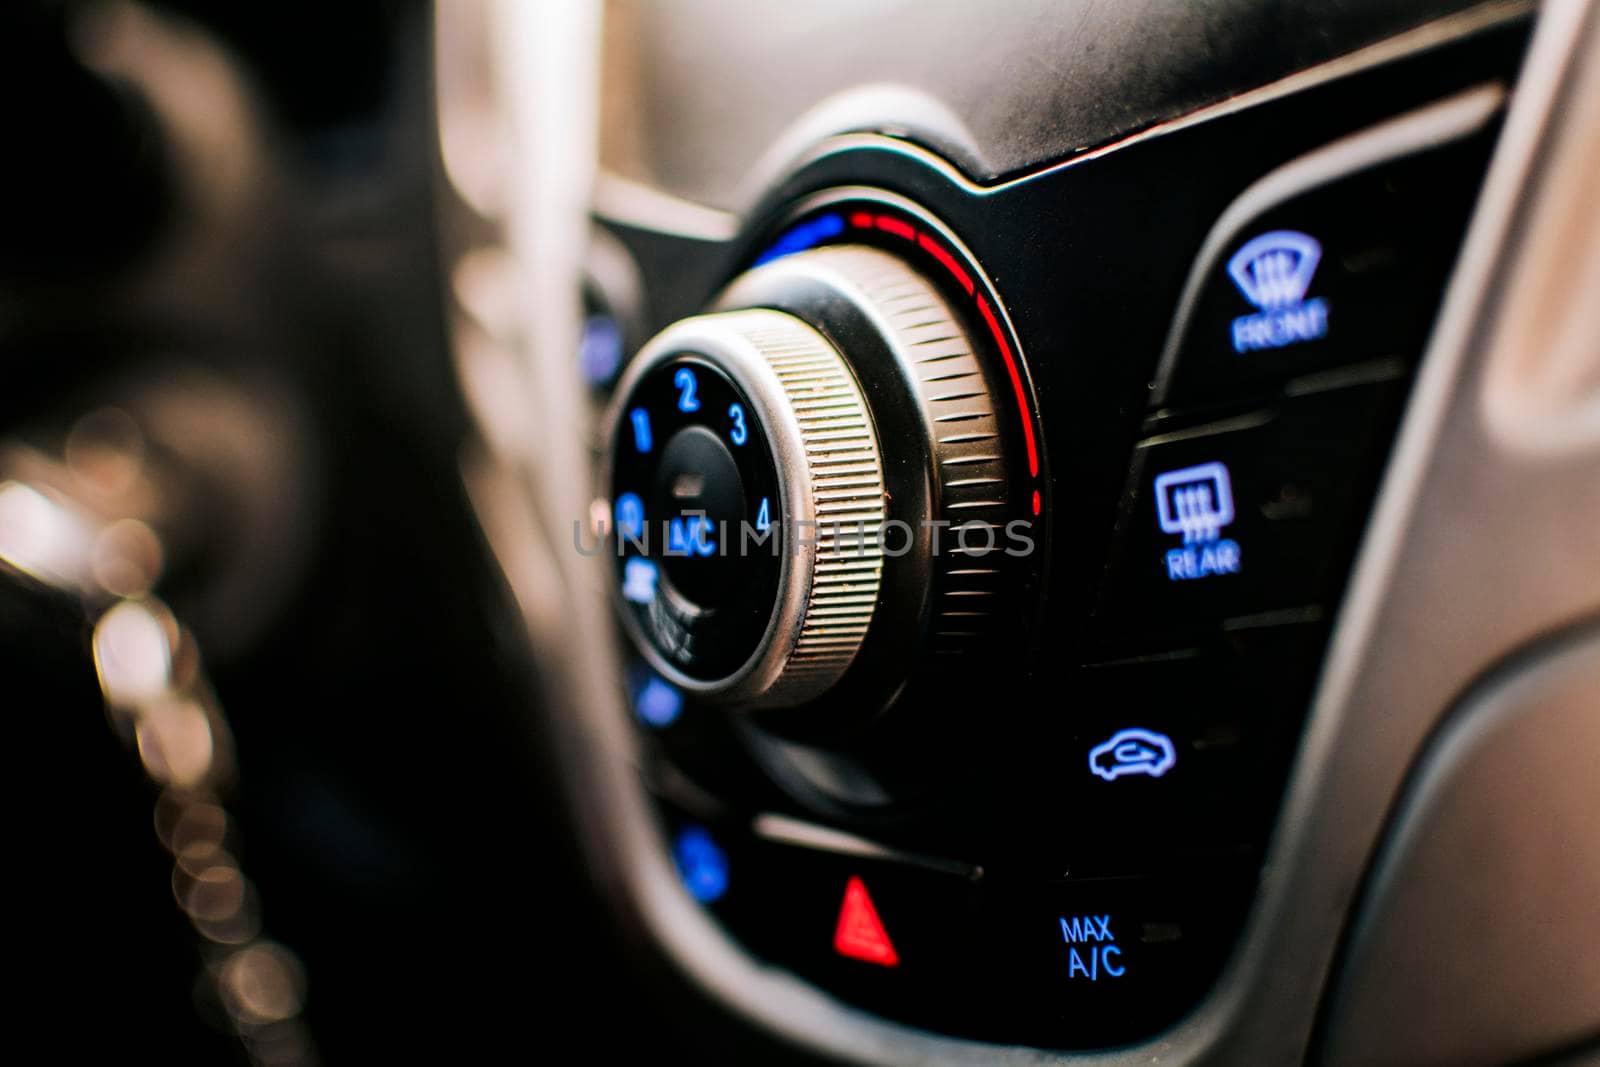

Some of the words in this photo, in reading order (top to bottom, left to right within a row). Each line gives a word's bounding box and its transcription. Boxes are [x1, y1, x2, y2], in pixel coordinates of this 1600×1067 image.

[1231, 298, 1329, 352] FRONT
[675, 368, 700, 412] 2
[630, 407, 653, 452] 1
[729, 403, 748, 446] 3
[615, 492, 645, 541] 0
[756, 497, 771, 533] 4
[1165, 539, 1241, 580] REAR
[1060, 915, 1115, 943] MAX
[1069, 945, 1126, 981] A/C
